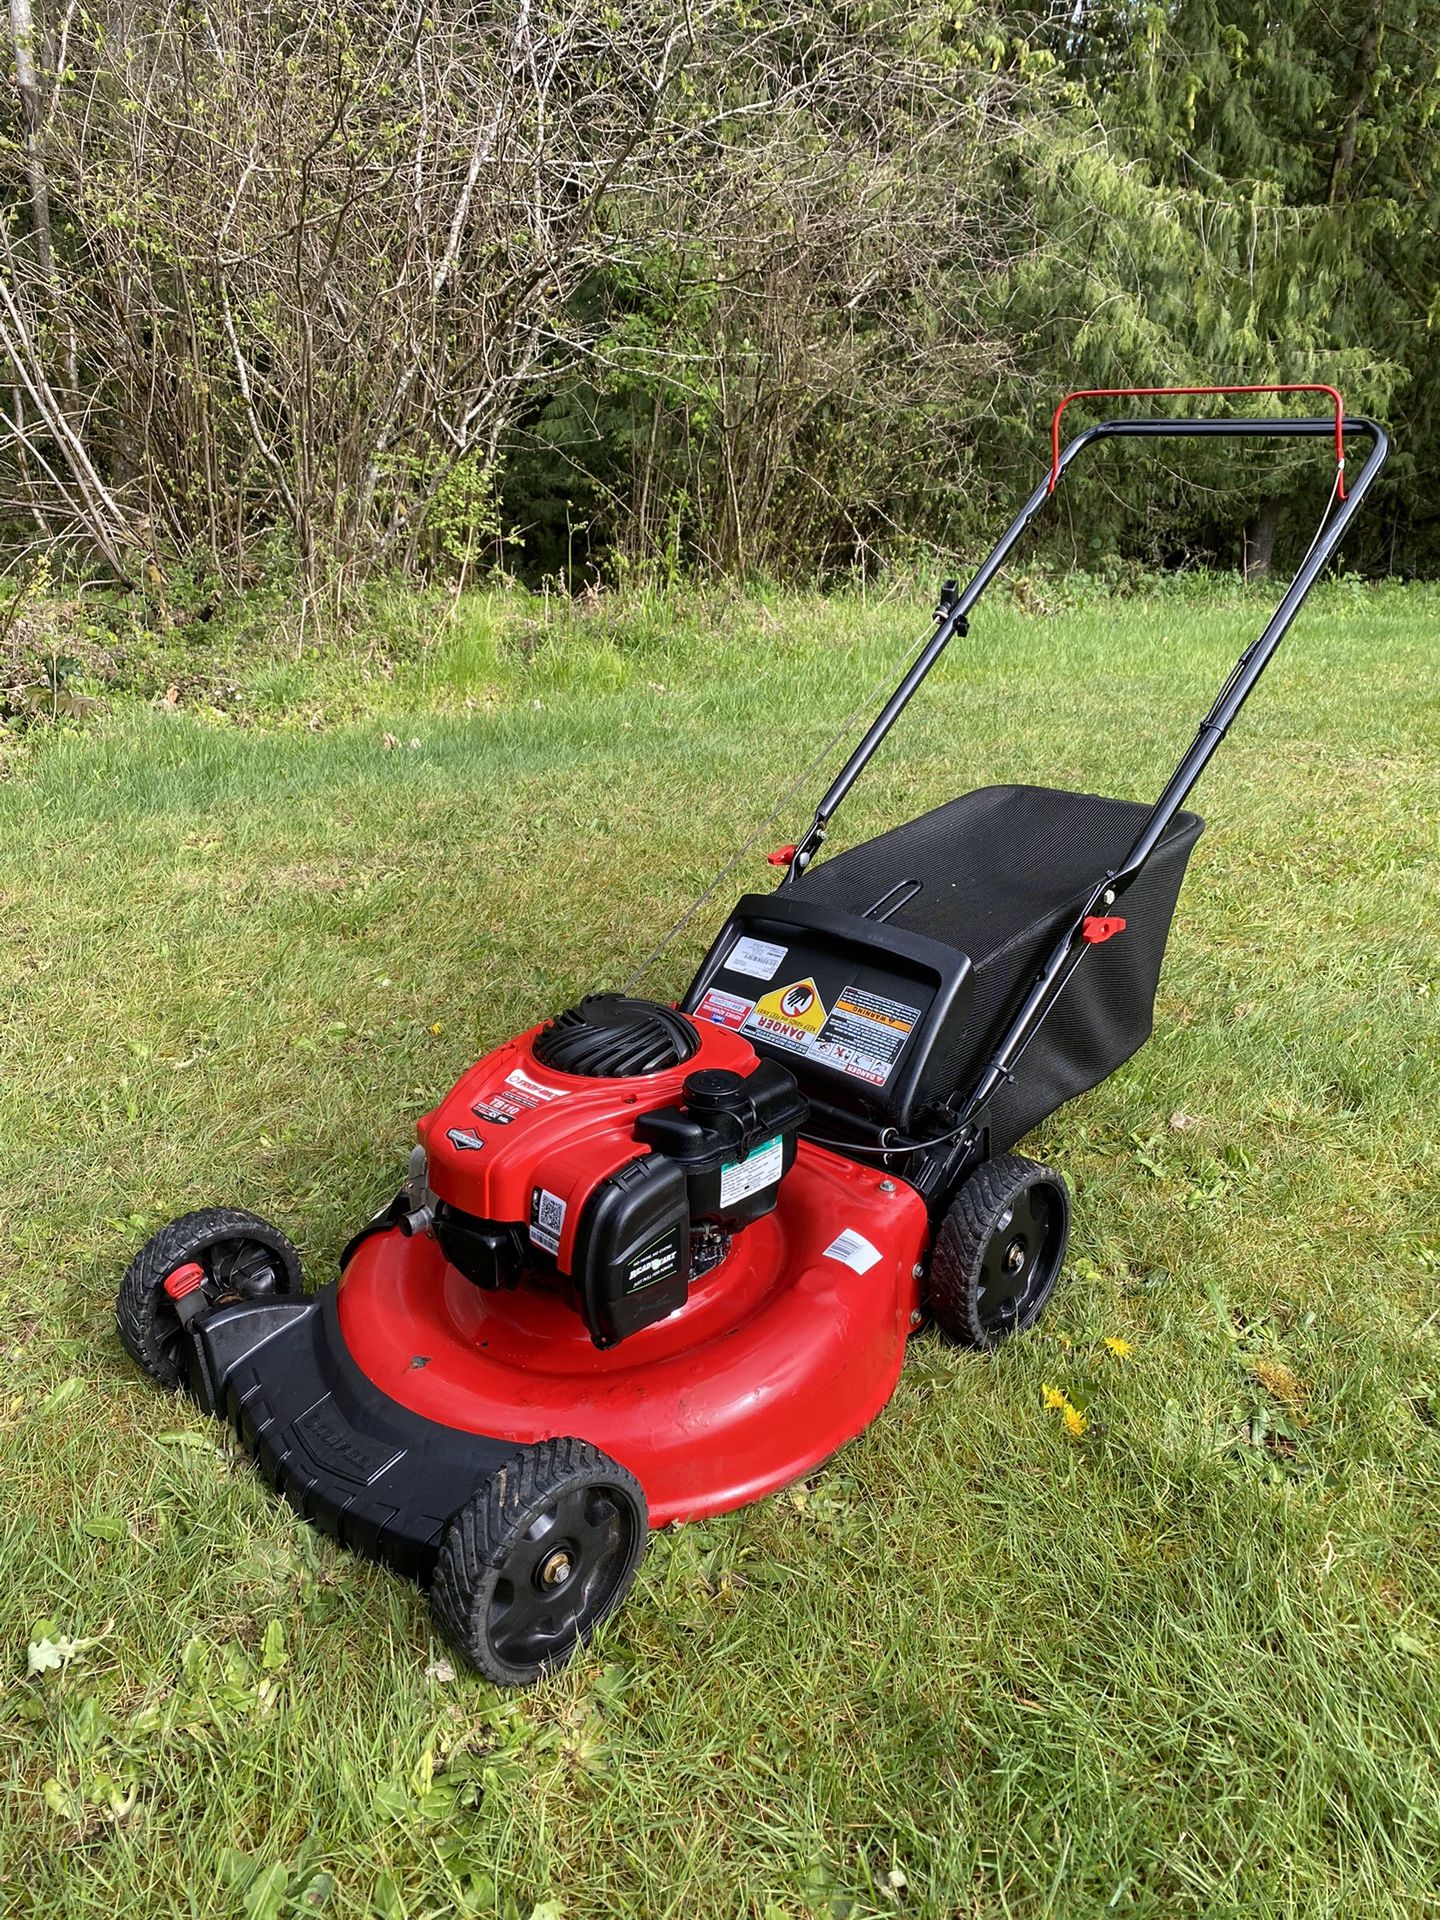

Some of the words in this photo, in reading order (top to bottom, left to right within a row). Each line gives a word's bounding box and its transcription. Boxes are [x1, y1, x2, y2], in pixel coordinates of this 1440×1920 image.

[757, 1008, 770, 1016] AWAY
[769, 1012, 781, 1020] FEET
[852, 1006, 887, 1022] WARNING
[757, 1016, 806, 1040] DANGER
[787, 1018, 804, 1027] HANDS
[803, 1024, 816, 1032] KEEP
[847, 1064, 876, 1080] DANGER
[489, 1098, 520, 1115] TB110
